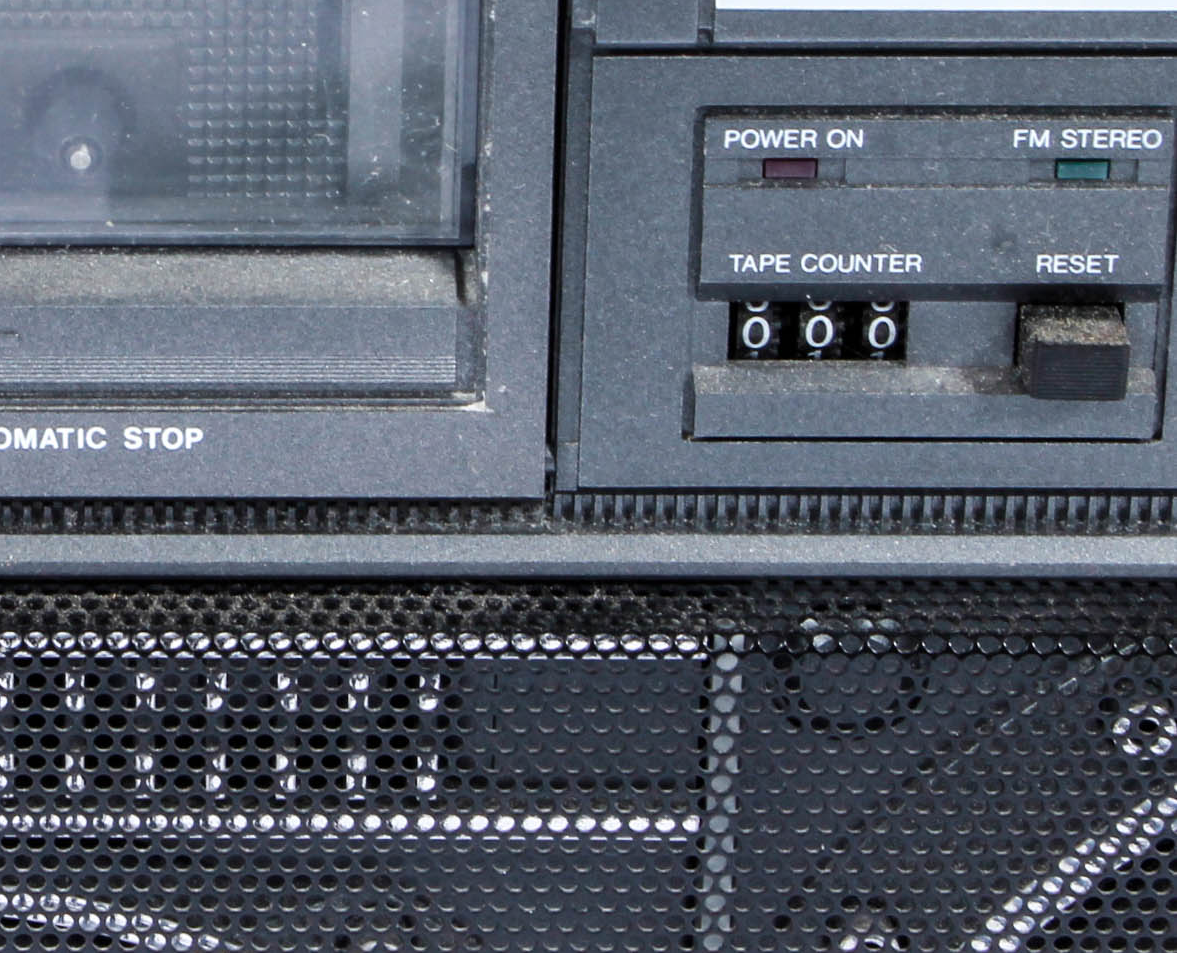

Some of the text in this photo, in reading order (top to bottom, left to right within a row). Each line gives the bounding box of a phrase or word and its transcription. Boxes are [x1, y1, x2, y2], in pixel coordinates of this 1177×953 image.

[723, 128, 864, 149] POWER ON
[1013, 128, 1163, 149] FM STEREO
[728, 253, 923, 274] TAPE COUNTER
[1036, 253, 1120, 274] RESET
[122, 426, 204, 450] STOP
